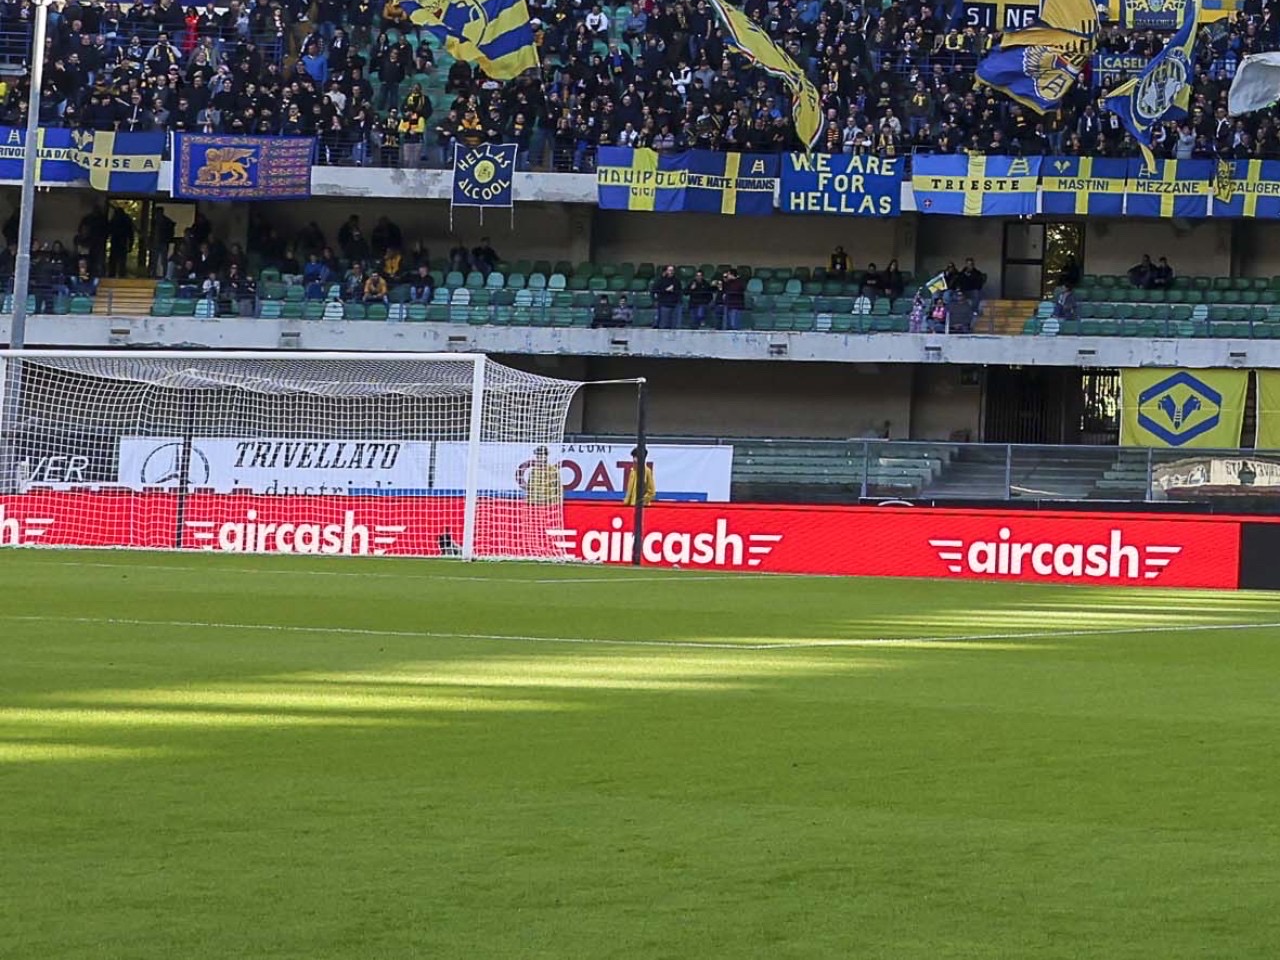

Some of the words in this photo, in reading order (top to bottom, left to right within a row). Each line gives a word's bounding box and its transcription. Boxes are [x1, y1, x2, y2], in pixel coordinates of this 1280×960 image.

[458, 144, 512, 172] HELLAS
[790, 152, 832, 173] WE
[846, 156, 898, 177] ARE
[457, 177, 512, 201] ALCOOL
[687, 175, 704, 187] WE
[706, 175, 732, 189] HATE
[735, 177, 775, 191] HUMANS
[818, 173, 865, 193] FOR
[931, 178, 1020, 191] TRIESTE
[1058, 178, 1110, 191] MASTINI
[1136, 180, 1200, 194] MEZZANE
[789, 191, 893, 215] HELLAS
[233, 441, 402, 470] TRIVELLATO
[218, 509, 369, 555] aircash
[581, 516, 744, 566] aircash
[967, 526, 1141, 579] aircash
